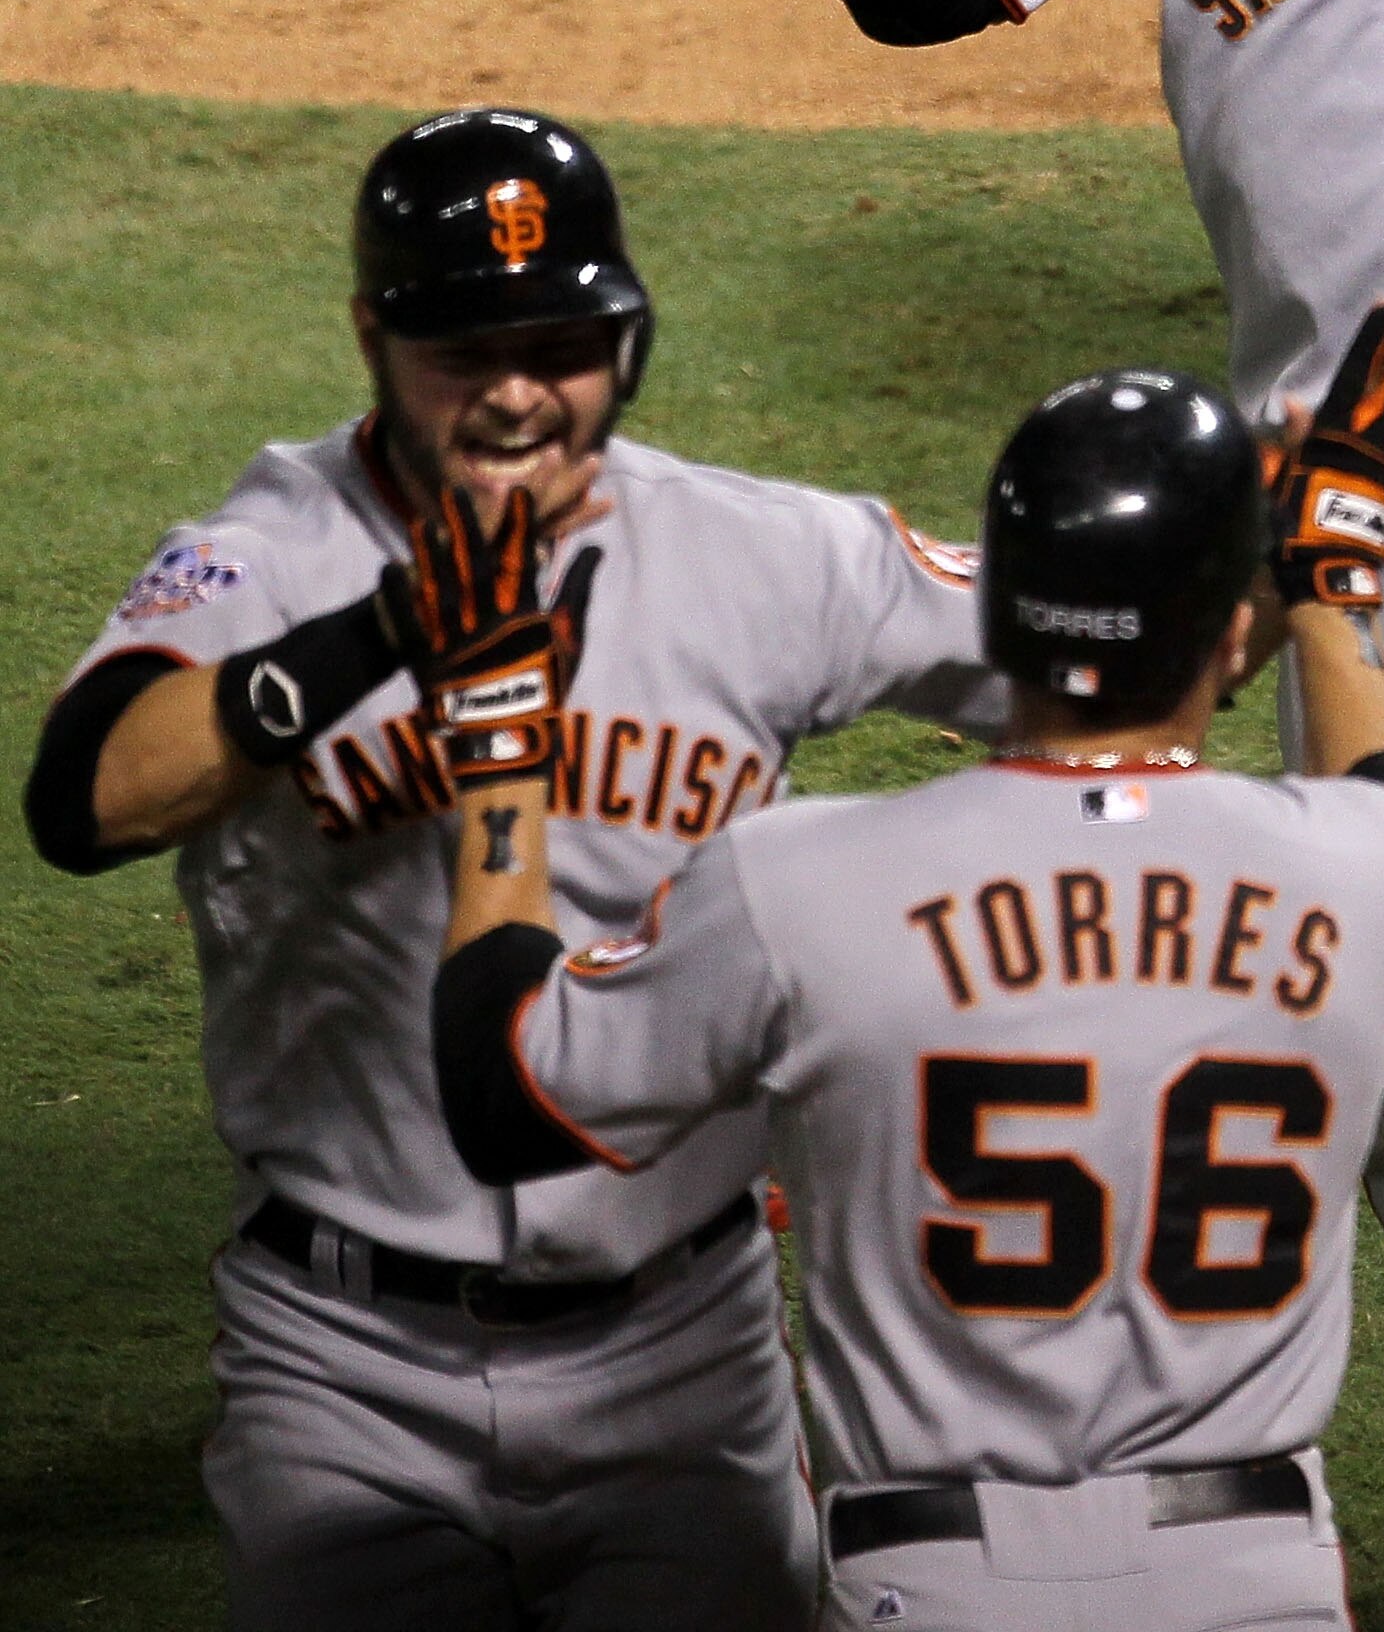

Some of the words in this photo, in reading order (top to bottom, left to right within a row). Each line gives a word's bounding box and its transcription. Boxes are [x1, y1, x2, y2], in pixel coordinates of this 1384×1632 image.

[1015, 595, 1141, 641] TORRES
[295, 712, 455, 841] SAN
[907, 866, 1340, 1018] TORRES
[917, 1051, 1335, 1323] 56
